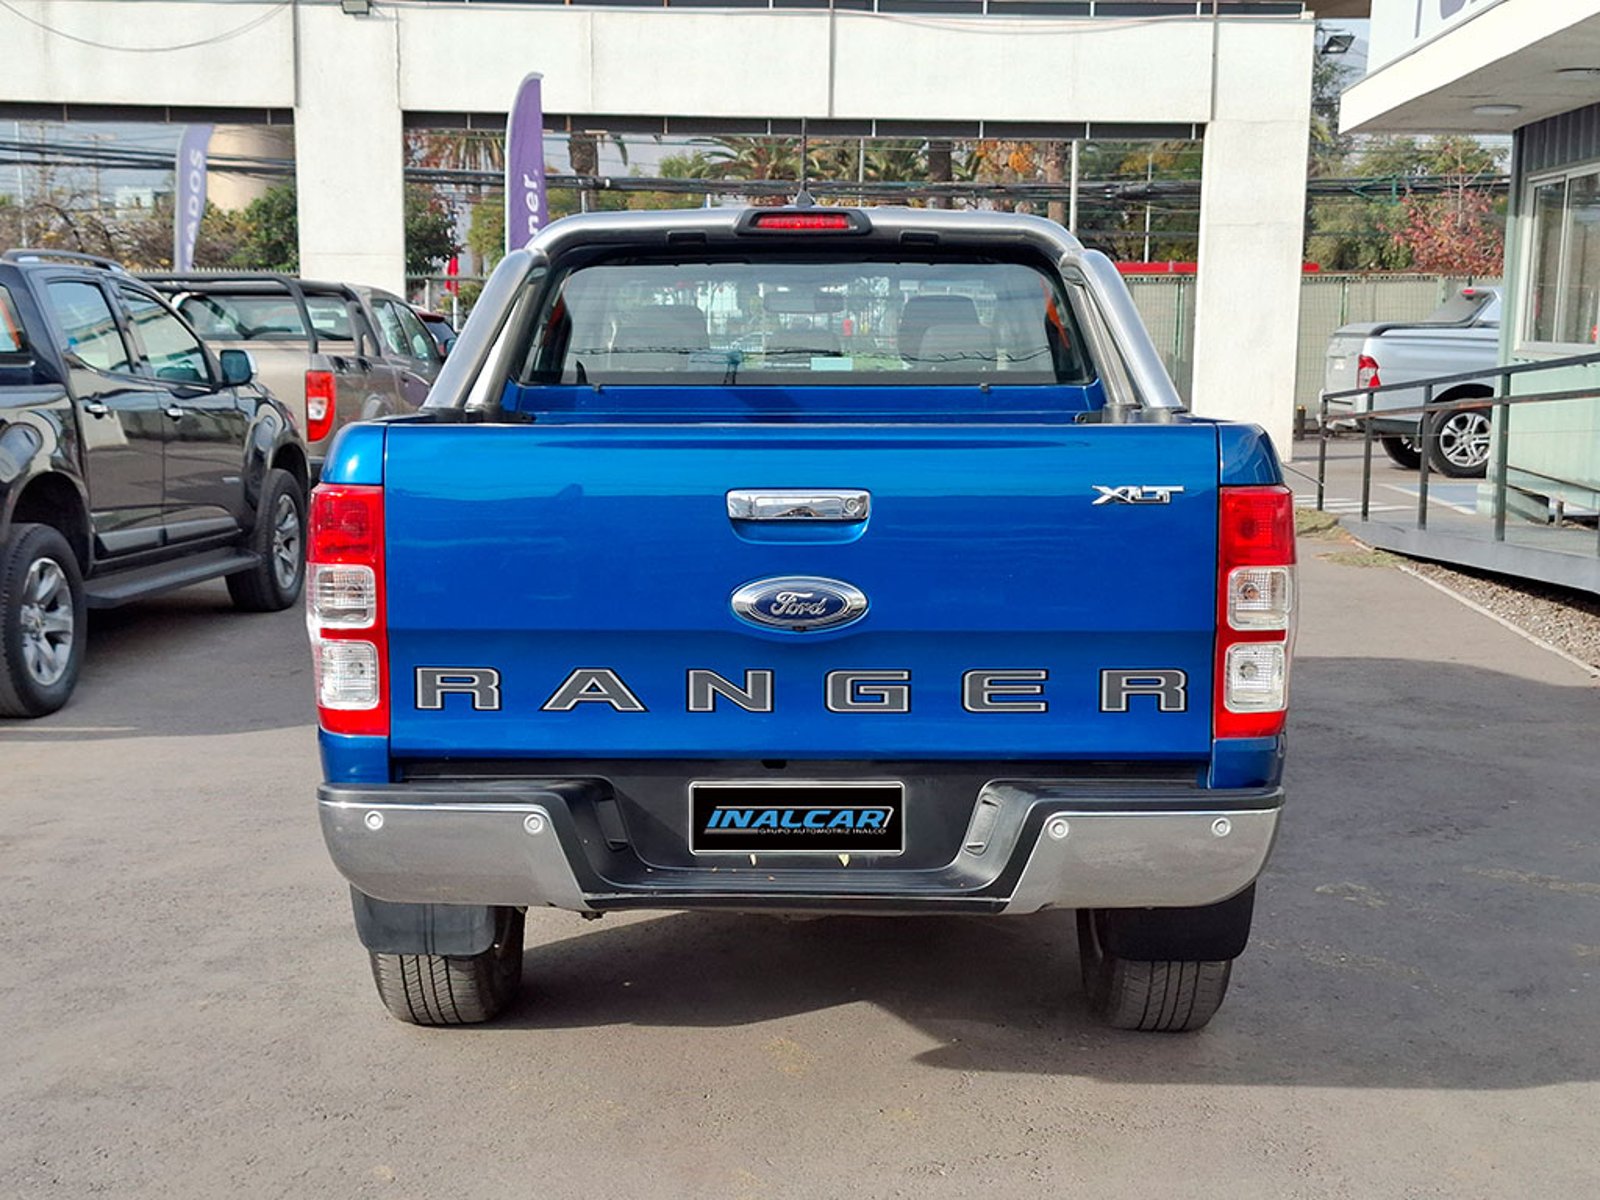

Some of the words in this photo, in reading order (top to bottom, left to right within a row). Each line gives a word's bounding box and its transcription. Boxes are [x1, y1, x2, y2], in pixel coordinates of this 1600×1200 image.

[1091, 485, 1185, 505] XLT
[770, 591, 828, 616] Ford
[414, 666, 1190, 713] RANGER
